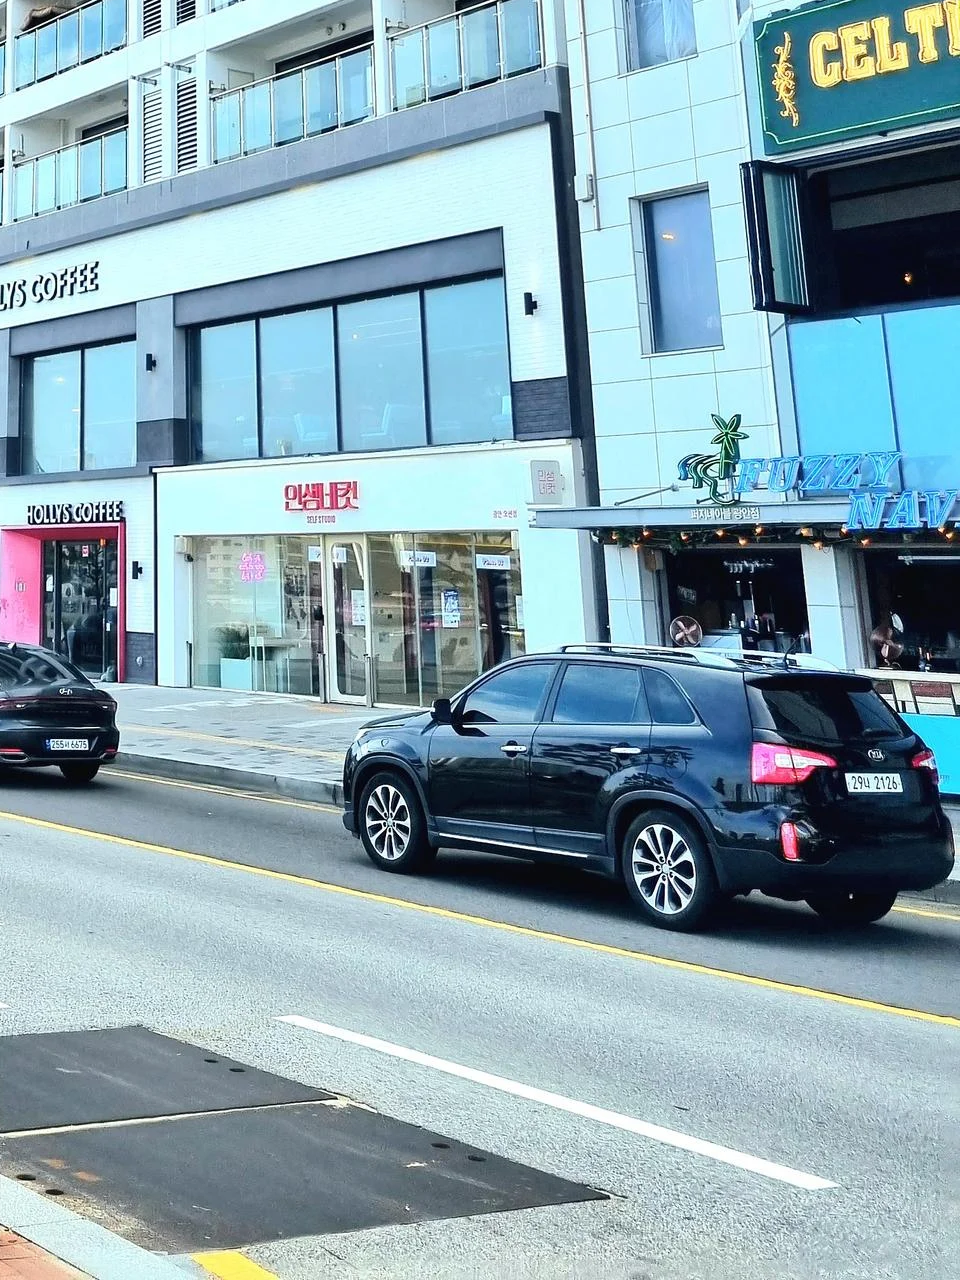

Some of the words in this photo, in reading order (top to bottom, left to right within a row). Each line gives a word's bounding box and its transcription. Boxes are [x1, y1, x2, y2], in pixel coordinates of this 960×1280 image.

[31, 261, 100, 303] COFFEE
[735, 451, 902, 493] FUZZY
[27, 503, 72, 525] HOLLYS
[73, 500, 124, 524] COFFEE
[690, 507, 732, 521] 퍼지네이블
[733, 507, 761, 521] 광안점
[844, 489, 960, 529] NAV
[306, 515, 318, 524] SELF
[318, 515, 336, 524] STUDIO
[71, 740, 87, 749] 6675
[873, 776, 898, 790] 2126
